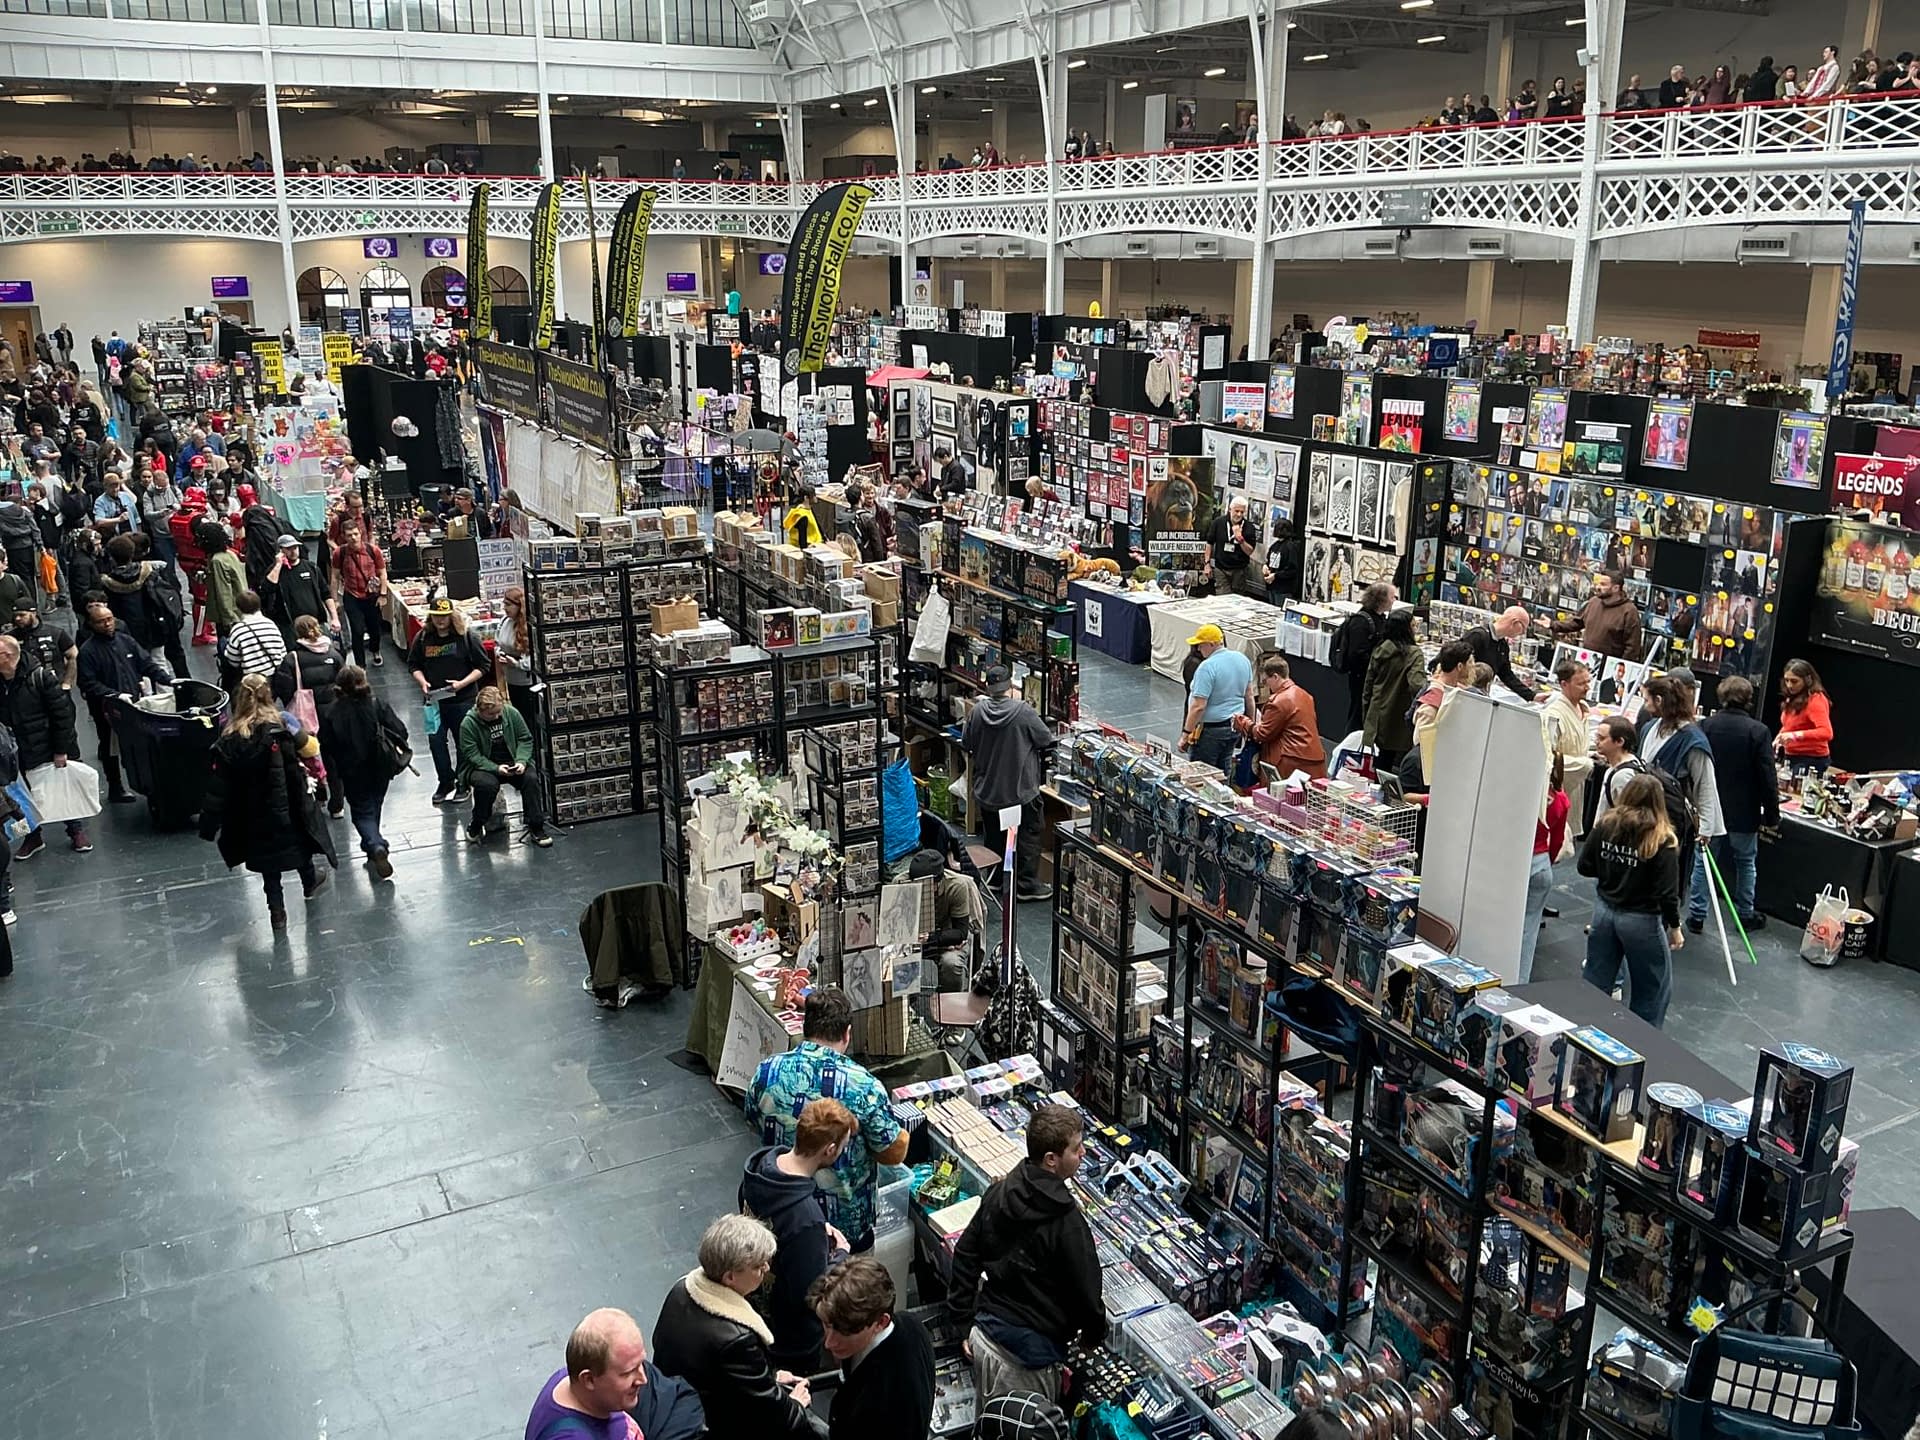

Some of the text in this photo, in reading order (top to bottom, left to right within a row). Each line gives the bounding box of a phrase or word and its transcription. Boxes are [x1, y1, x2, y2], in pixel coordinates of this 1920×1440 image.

[821, 210, 832, 224] Be
[800, 212, 819, 250] Replicas
[810, 224, 826, 256] Should
[538, 189, 562, 341] TheSwordStall.co.uk
[625, 193, 653, 329] TheSwordStall.co.uk
[798, 252, 806, 270] and
[804, 258, 818, 280] They
[804, 189, 867, 362] TheSwordStall.co.uk
[792, 272, 802, 307] Swords
[790, 310, 799, 337] Iconic
[330, 350, 348, 358] SOLD
[266, 369, 279, 377] ERE
[1382, 400, 1424, 416] DAVID
[1382, 414, 1422, 428] LEACH
[1838, 472, 1904, 496] LEGENDS
[1156, 531, 1200, 540] OUR INCREDIBLE
[1150, 542, 1206, 551] WILDLIFE NEEDS YOU
[1600, 850, 1638, 867] CONTI
[1601, 840, 1639, 857] ITALIA
[1476, 1354, 1539, 1403] DOCTOR WHO
